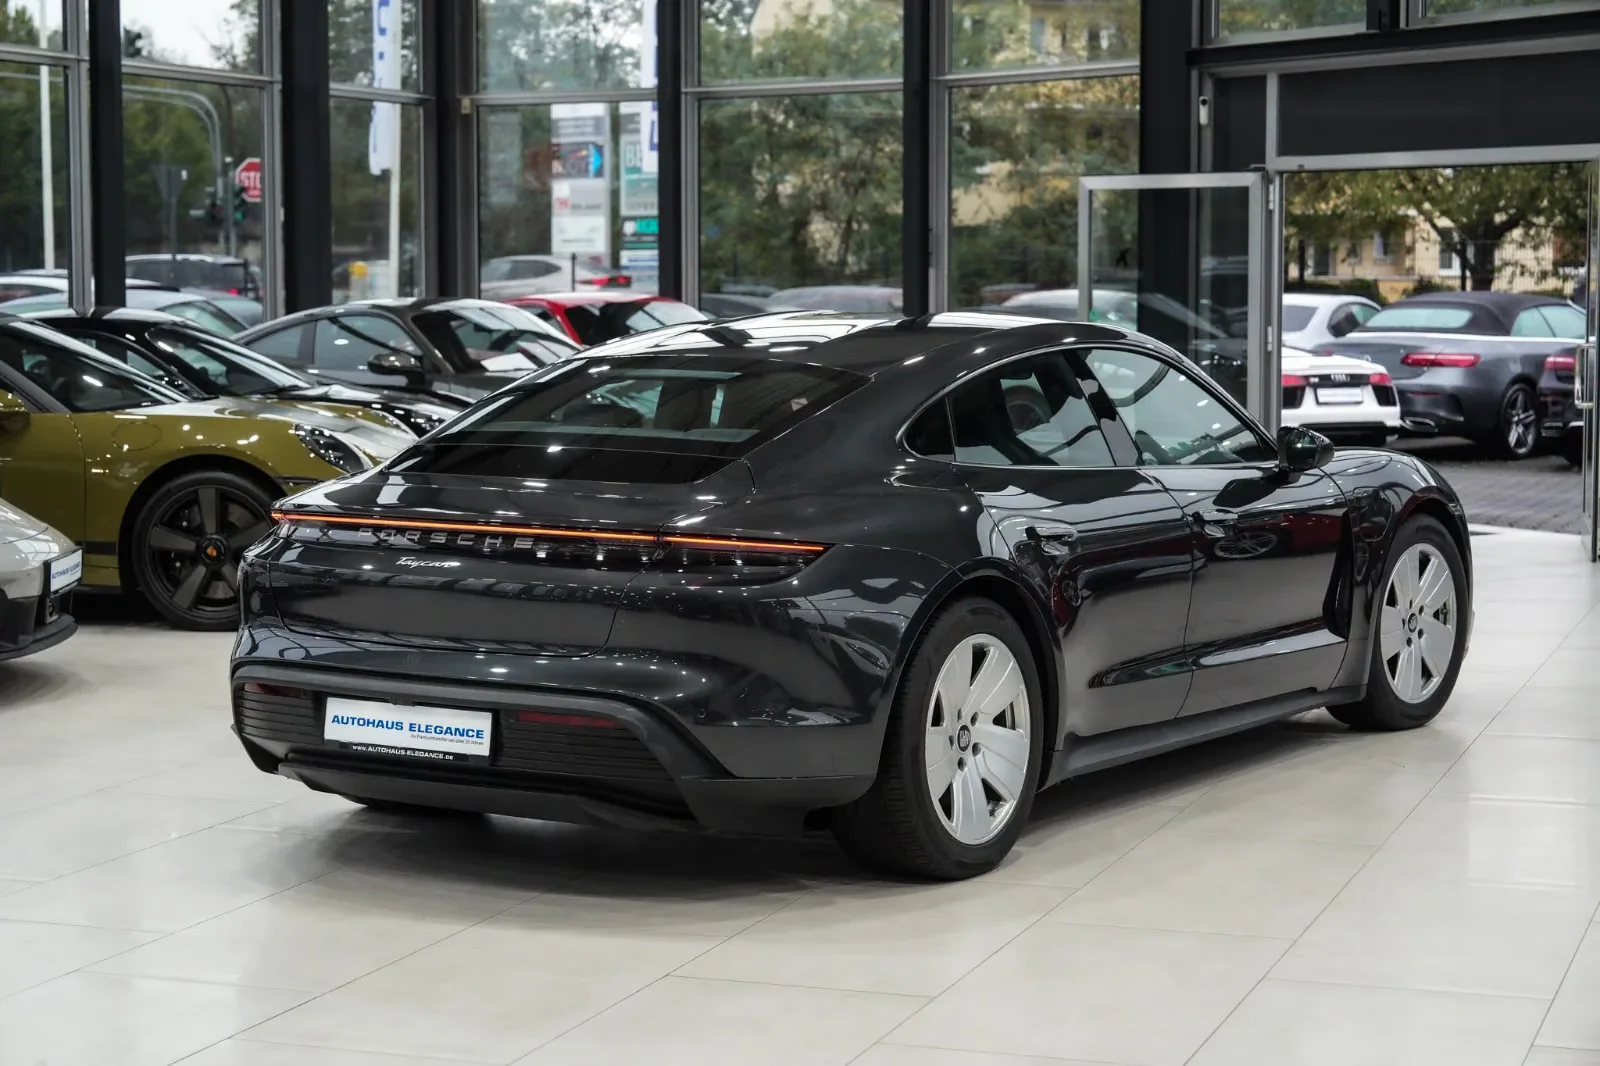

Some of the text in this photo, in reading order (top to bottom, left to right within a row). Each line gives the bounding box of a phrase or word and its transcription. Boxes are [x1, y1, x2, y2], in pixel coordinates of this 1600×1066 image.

[358, 527, 534, 548] PORSCHE
[396, 556, 461, 569] Taycan
[331, 714, 485, 739] AUTOHAUS ELEGANCE
